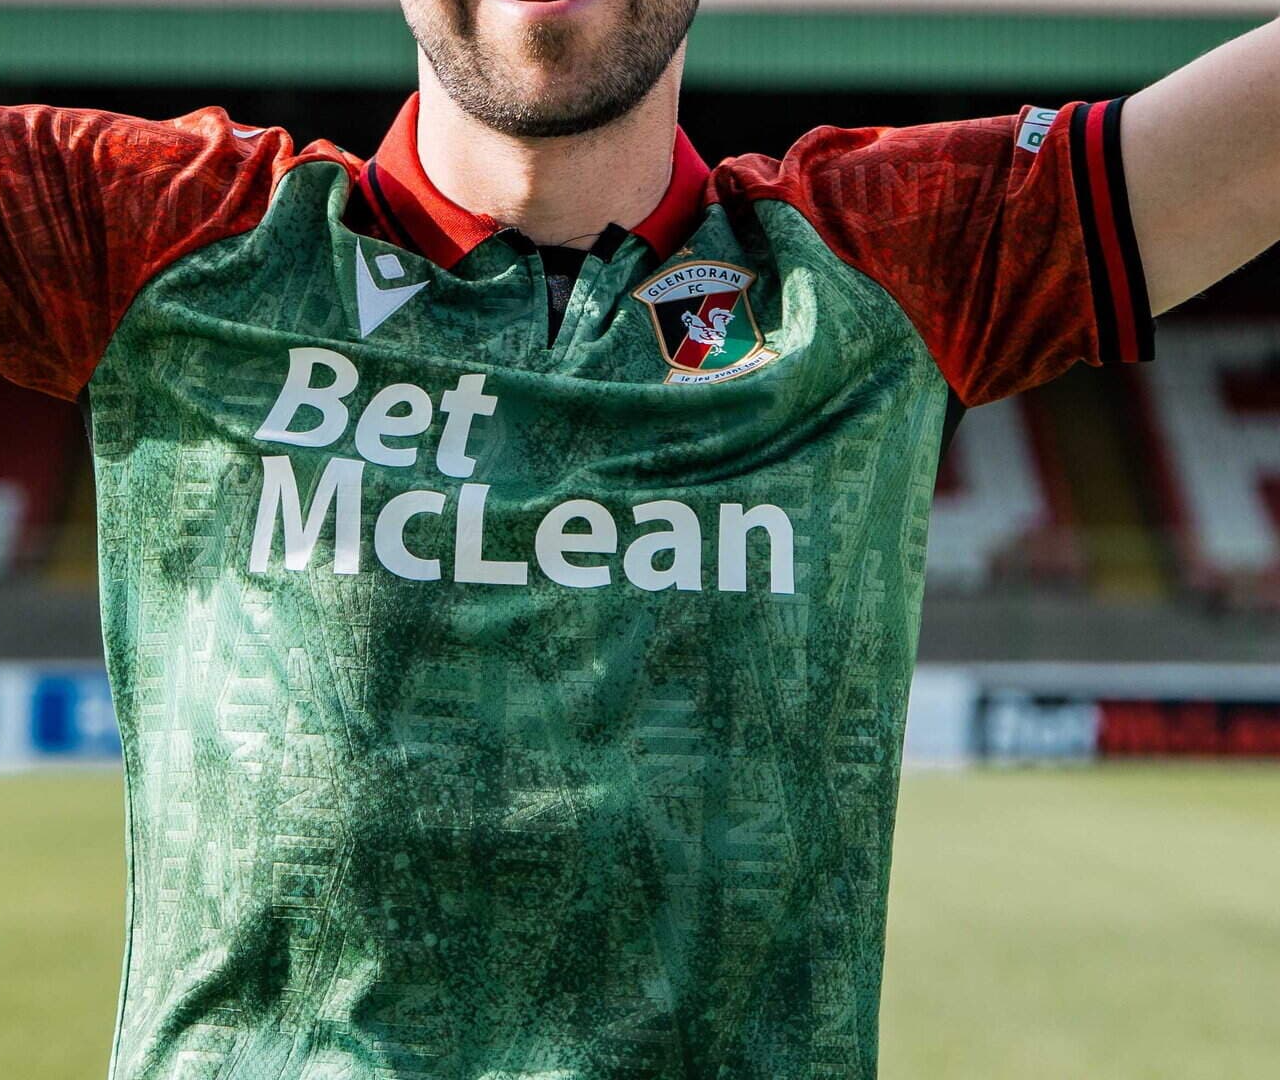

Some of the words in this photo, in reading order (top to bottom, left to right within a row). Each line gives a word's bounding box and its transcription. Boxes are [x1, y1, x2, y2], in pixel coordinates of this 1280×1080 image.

[648, 267, 741, 297] GLENTORAN
[688, 283, 704, 294] FC
[714, 367, 744, 379] avant
[254, 347, 498, 479] Bet
[249, 455, 796, 595] McLean
